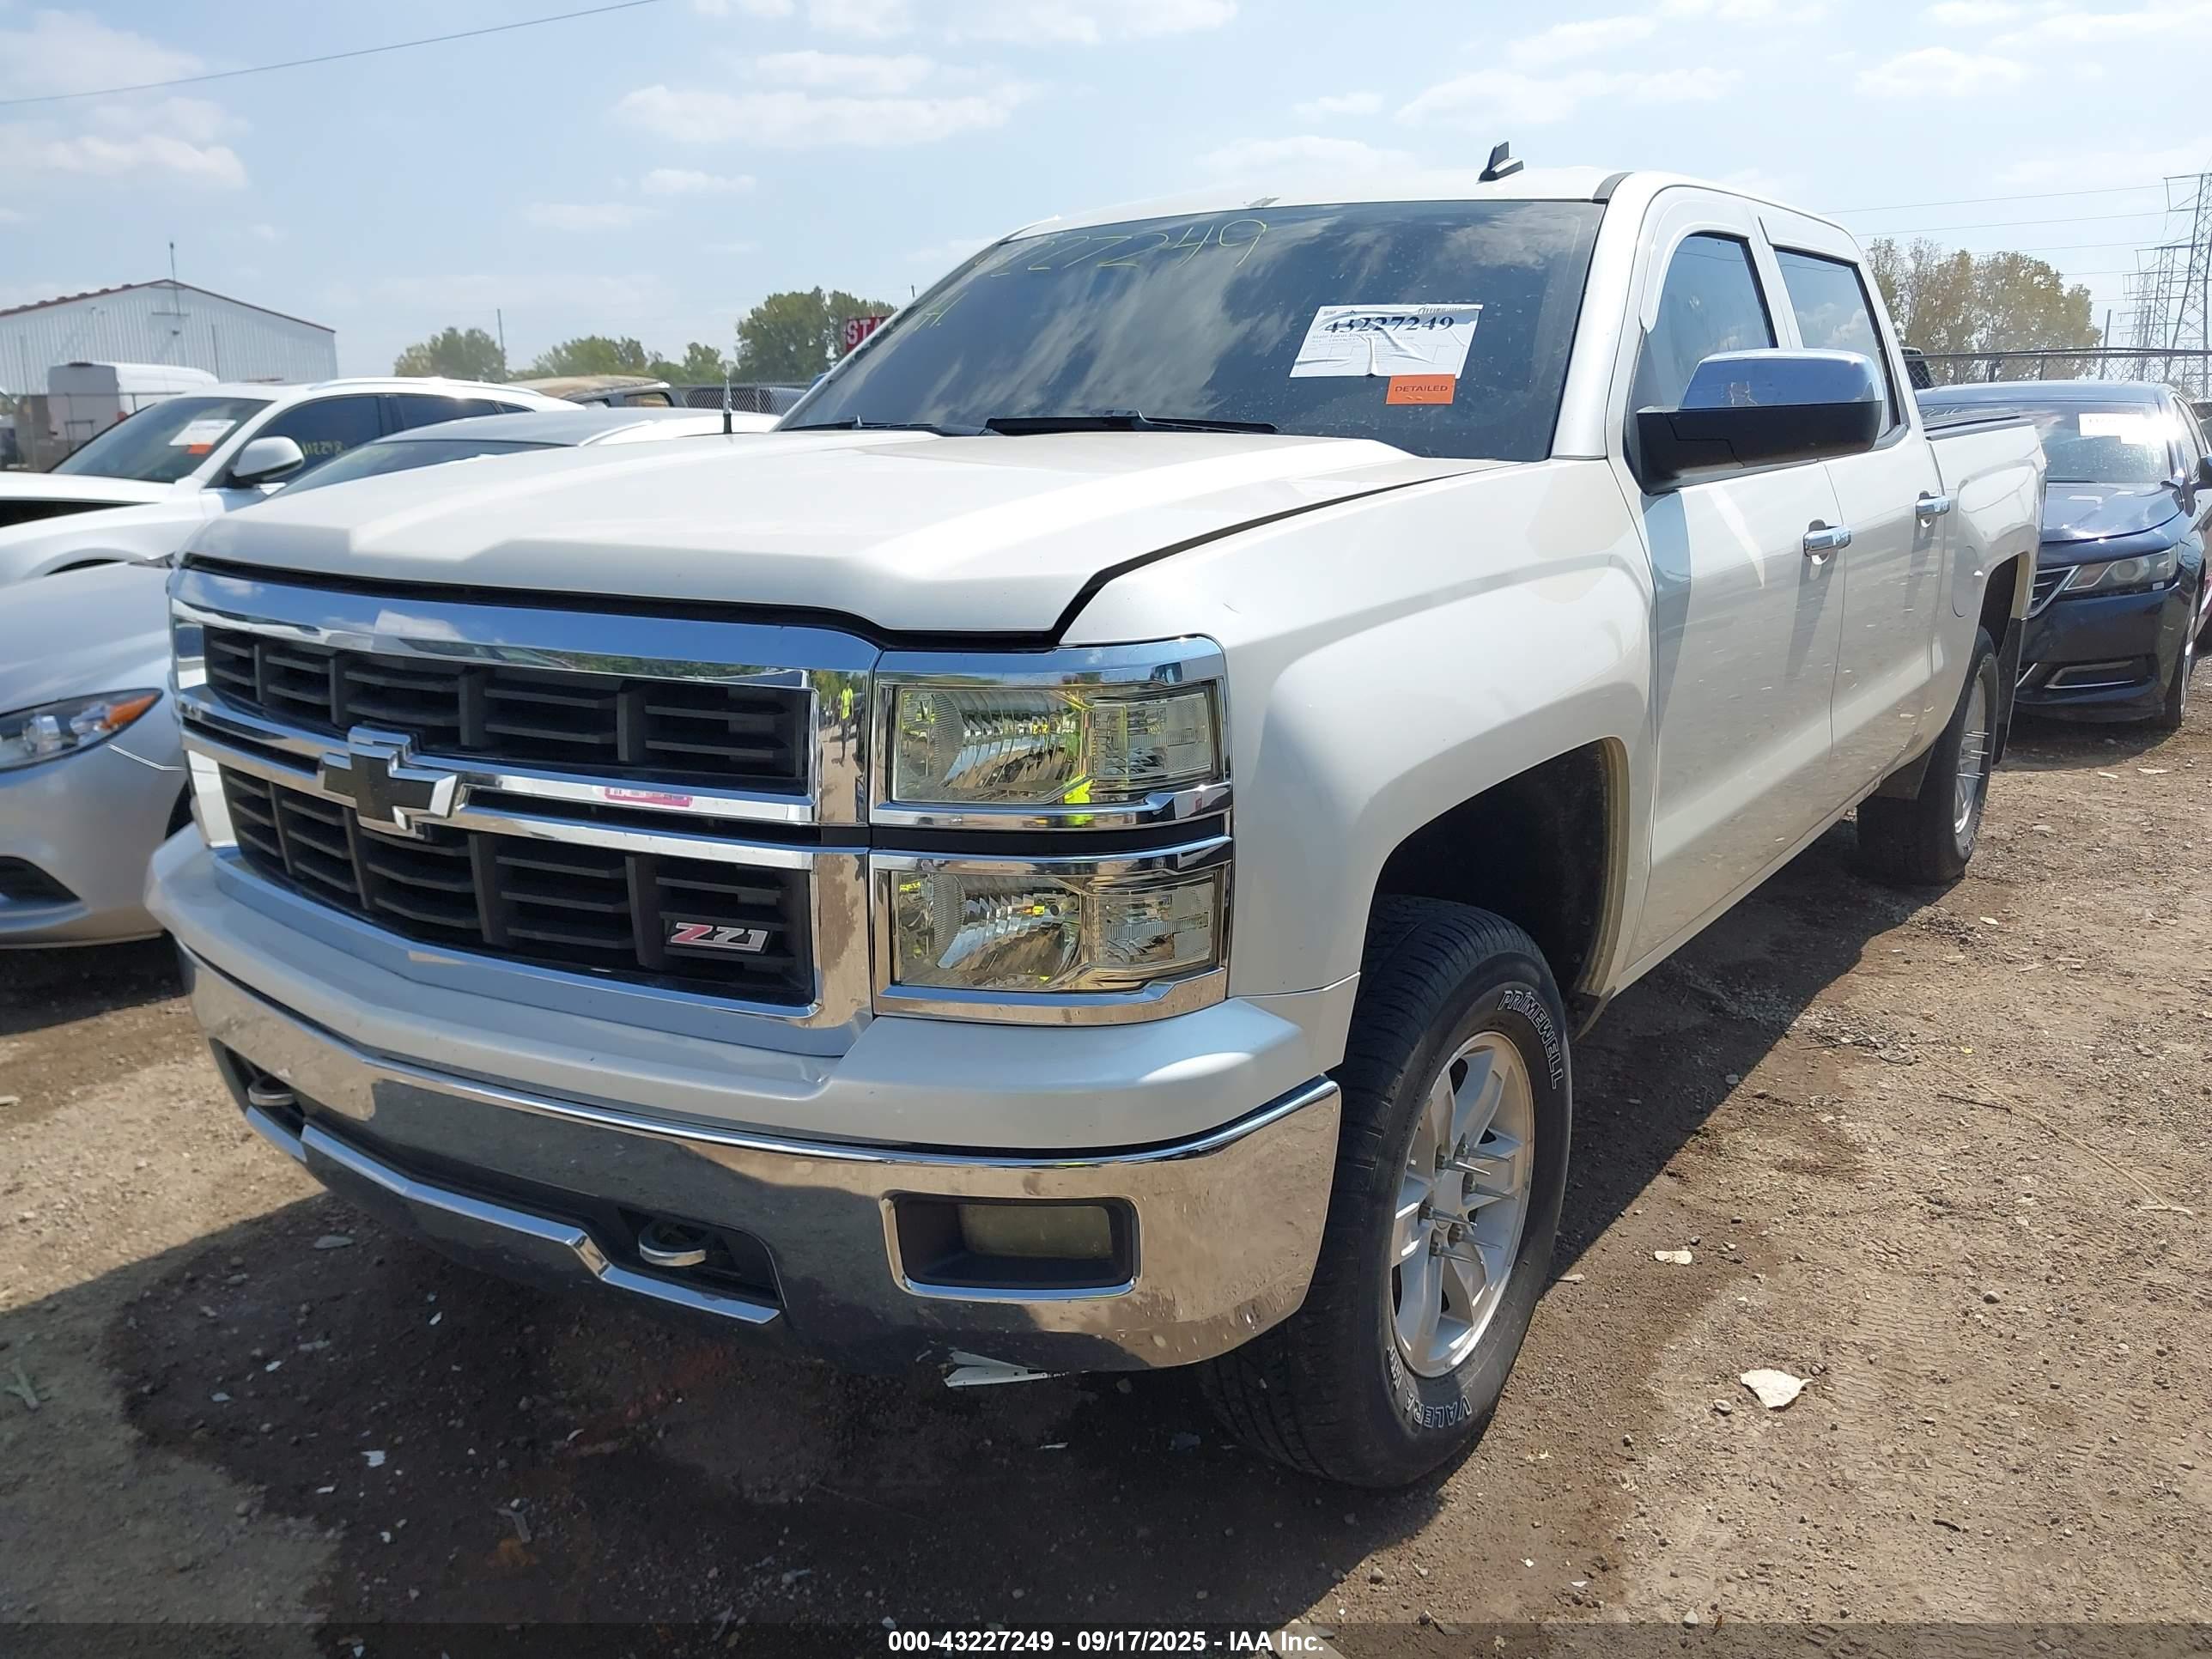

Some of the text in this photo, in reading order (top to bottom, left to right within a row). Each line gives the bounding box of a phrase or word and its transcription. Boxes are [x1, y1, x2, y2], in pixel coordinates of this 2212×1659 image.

[1324, 316, 1455, 332] 43227249
[670, 921, 769, 952] Z71
[1497, 990, 1564, 1090] PRIMEWELL
[1403, 1395, 1472, 1429] VALERA
